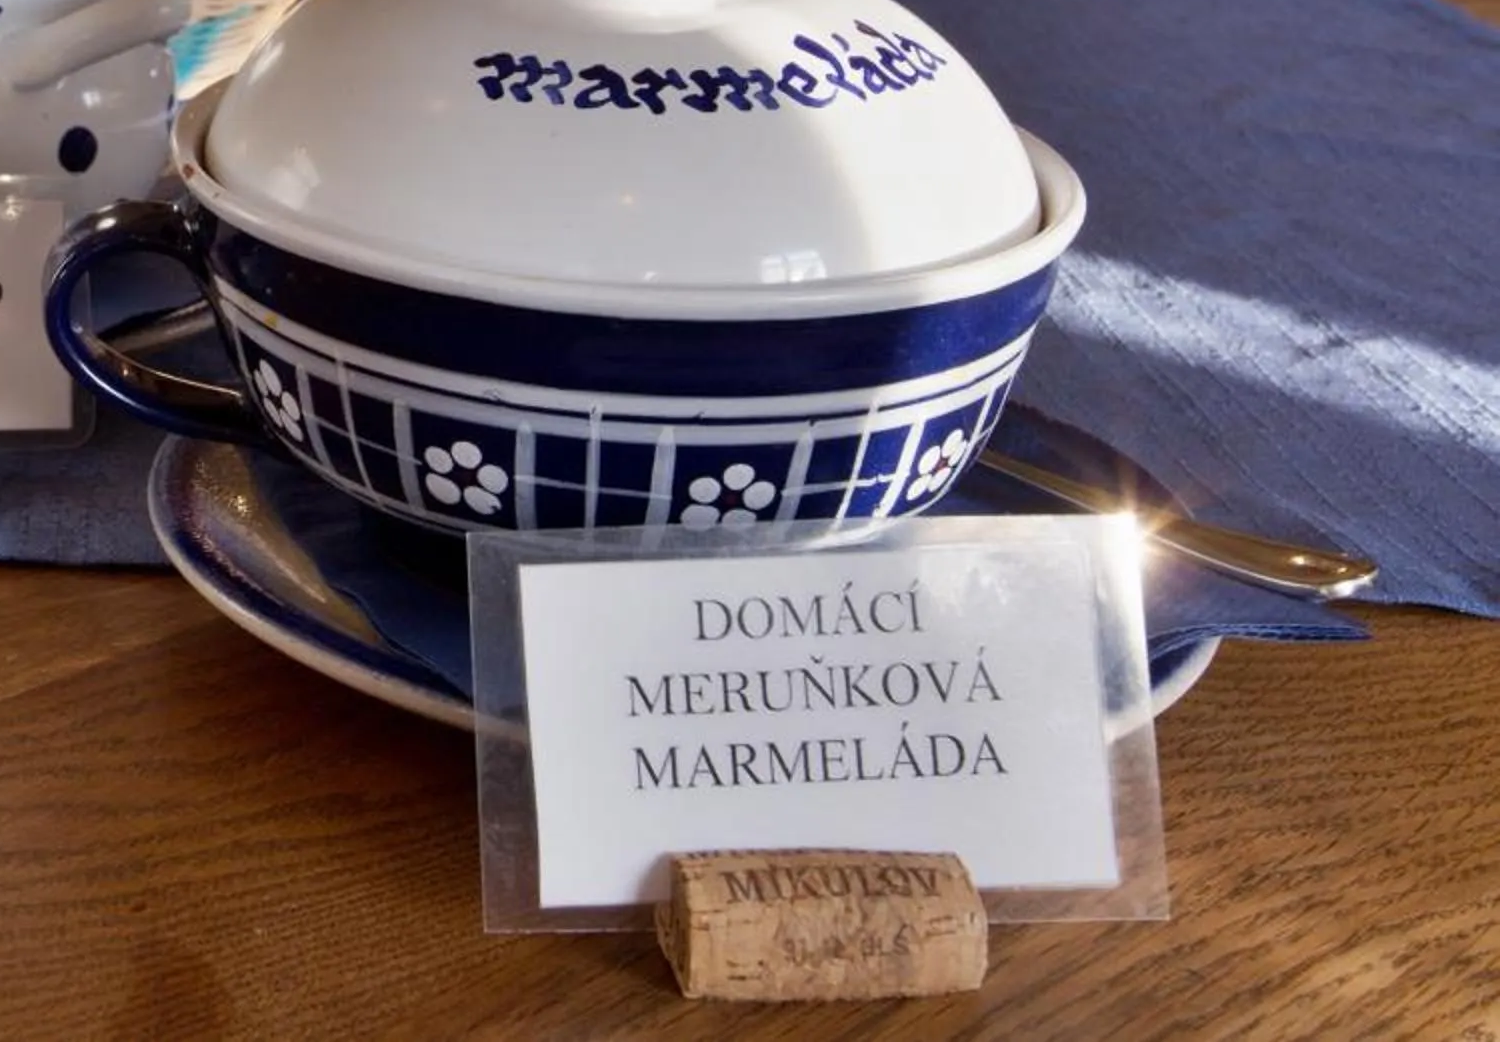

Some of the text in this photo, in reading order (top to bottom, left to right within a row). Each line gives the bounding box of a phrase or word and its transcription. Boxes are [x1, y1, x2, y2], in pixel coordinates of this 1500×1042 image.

[474, 19, 946, 114] marmeláda
[693, 579, 925, 641] DOMÁCÍ
[625, 647, 1002, 718] MERUŇKOVÁ
[633, 721, 1009, 790] MARMELÁDA
[718, 863, 942, 904] MIKULOV
